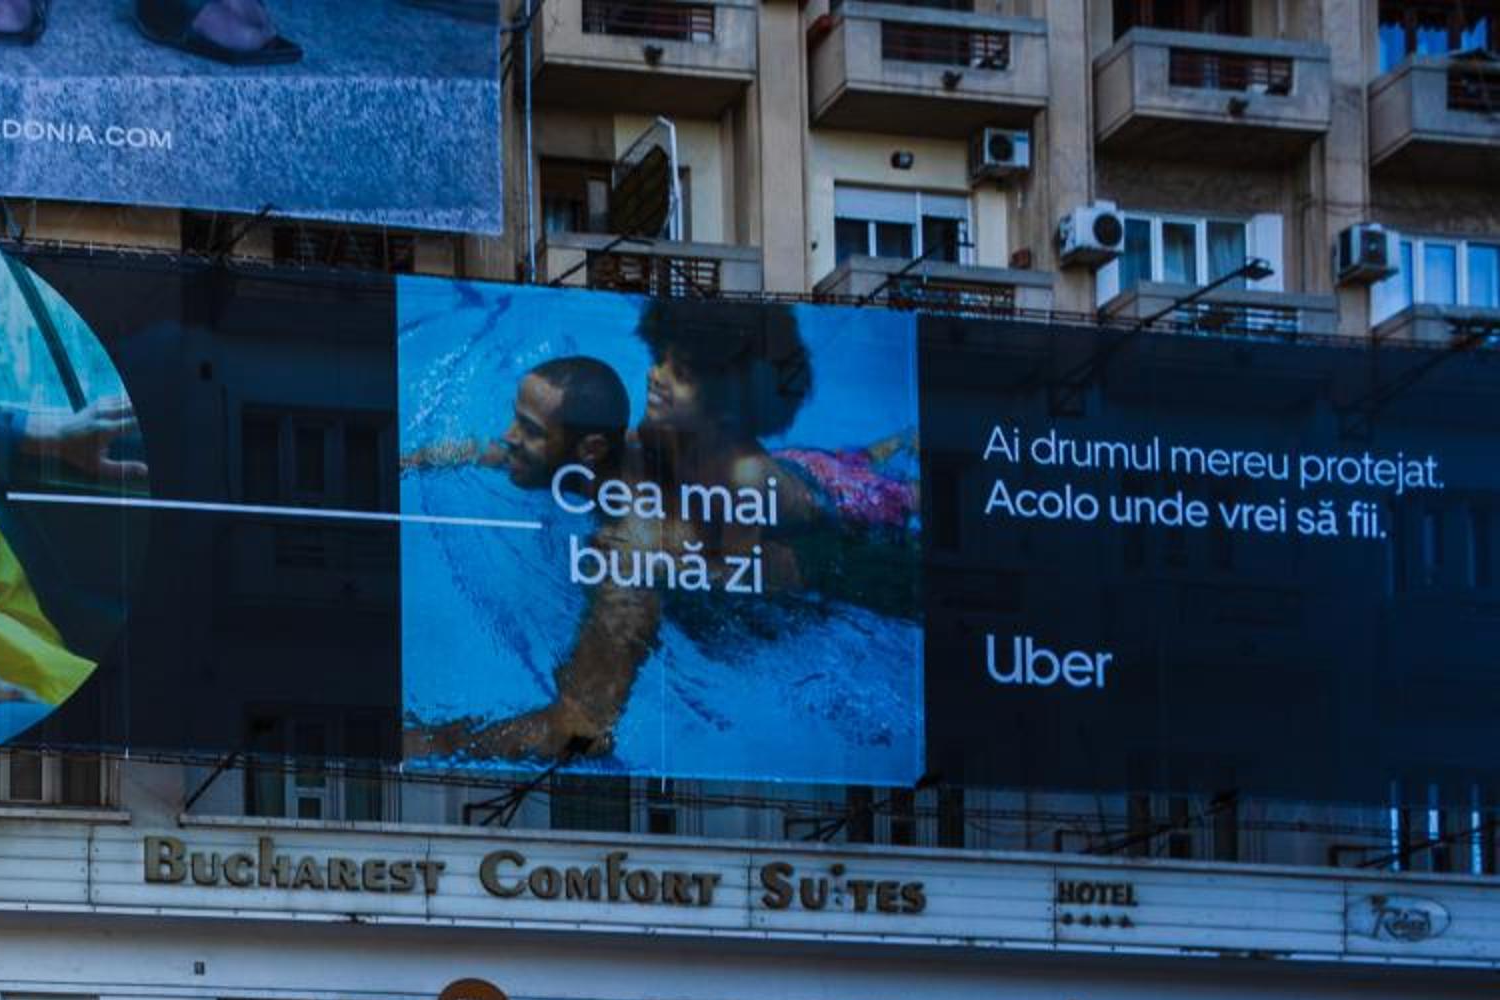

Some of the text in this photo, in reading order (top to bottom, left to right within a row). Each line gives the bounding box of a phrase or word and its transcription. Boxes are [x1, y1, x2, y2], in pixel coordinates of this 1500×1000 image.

[983, 426, 1444, 495] Ai drumul mereu protejat.
[551, 464, 778, 526] Cea mai
[984, 480, 1387, 539] Acolo unde vrei să fii.
[569, 534, 762, 594] bună zi
[985, 634, 1112, 687] Uber
[1057, 881, 1138, 906] HOTEL
